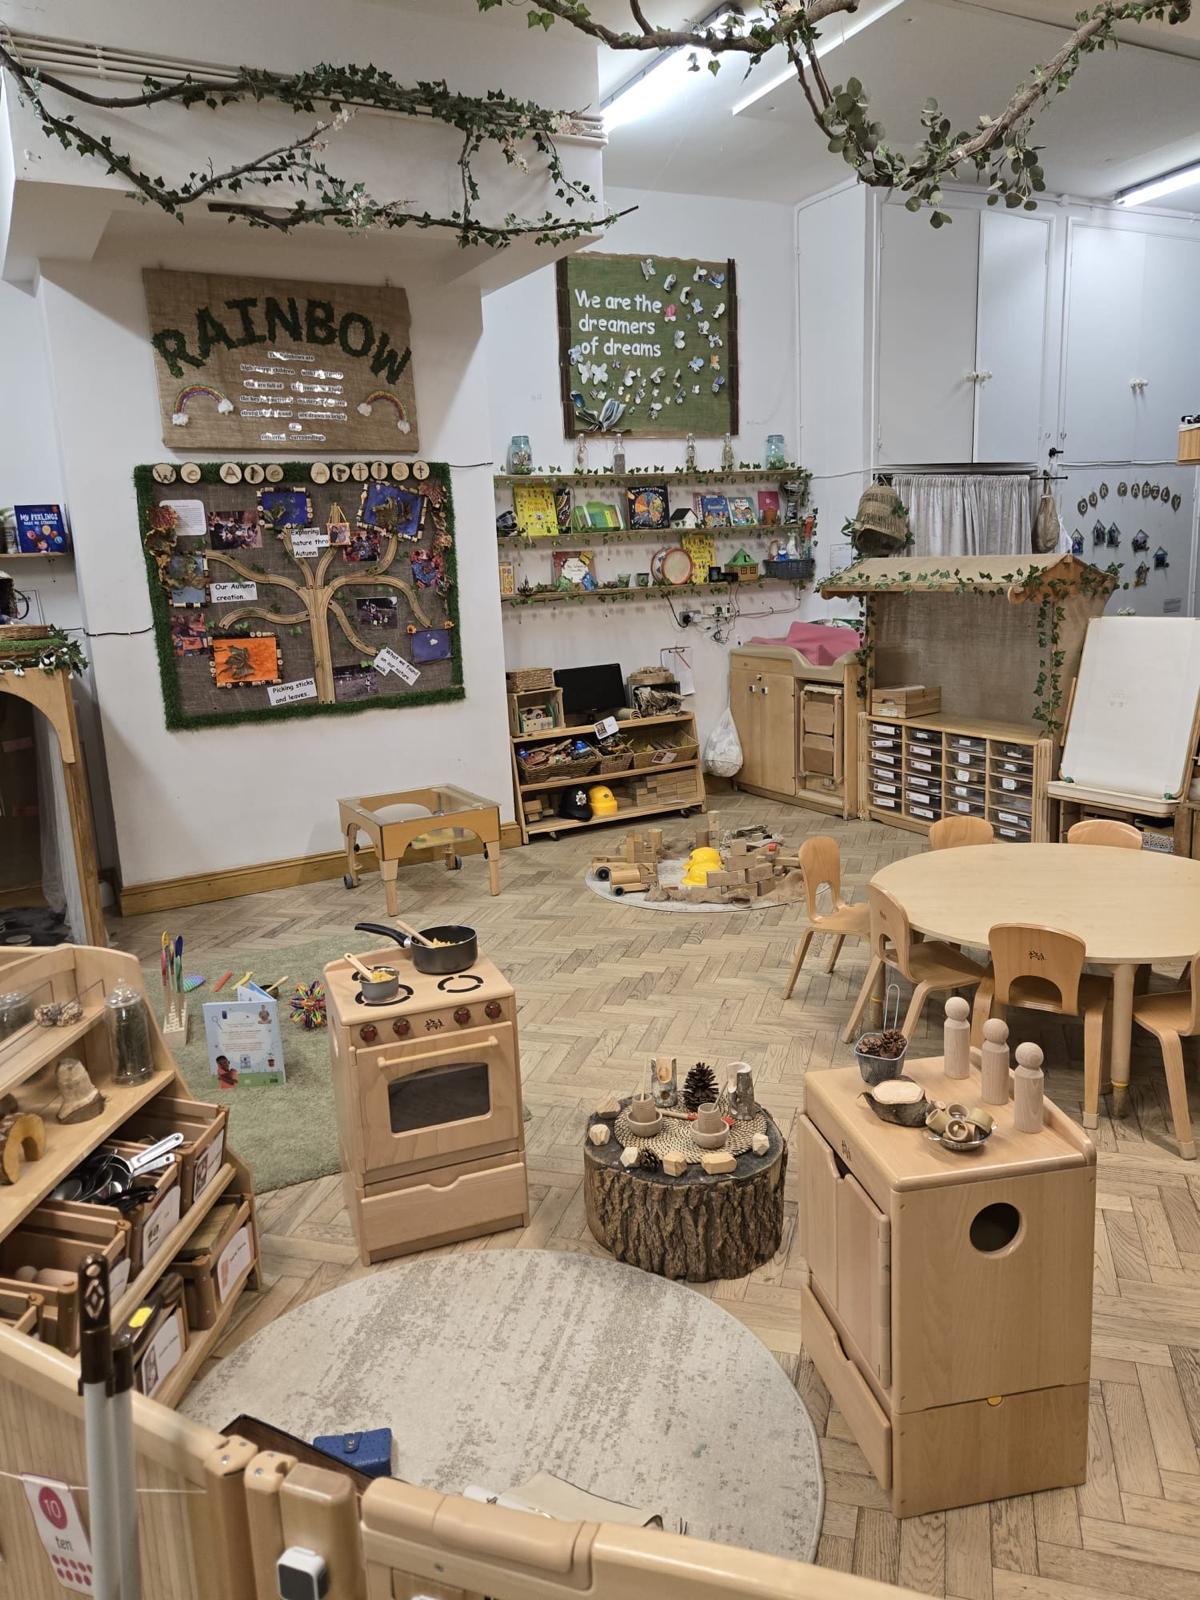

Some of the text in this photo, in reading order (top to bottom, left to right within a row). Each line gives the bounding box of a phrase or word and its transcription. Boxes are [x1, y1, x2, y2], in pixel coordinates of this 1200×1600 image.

[575, 289, 663, 314] We are the
[578, 313, 656, 335] dreamers
[151, 296, 412, 386] RAINBOW
[581, 336, 662, 358] of dreams
[153, 464, 200, 484] We
[1079, 483, 1181, 513] OUR FAMILY
[291, 529, 320, 537] Exploring
[230, 582, 256, 590] Autumn
[272, 679, 314, 694] Picking sticks
[275, 696, 287, 704] and
[44, 1499, 62, 1519] 10
[55, 1535, 74, 1552] ten
